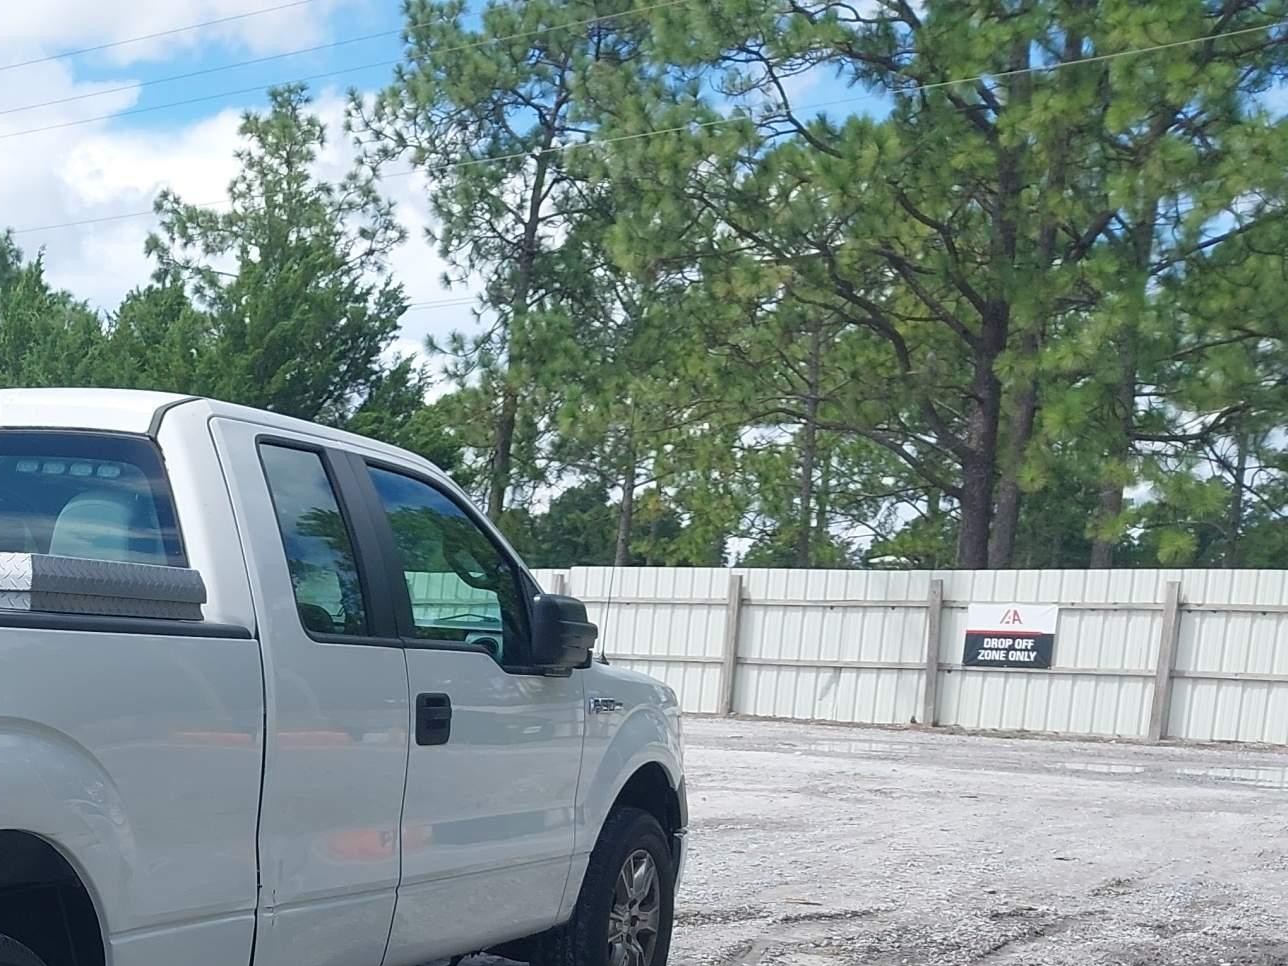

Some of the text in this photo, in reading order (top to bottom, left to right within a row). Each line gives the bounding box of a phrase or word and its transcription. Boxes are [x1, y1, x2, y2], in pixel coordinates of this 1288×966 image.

[983, 638, 1035, 649] DROP OFF
[977, 650, 1037, 662] ZONE ONLY
